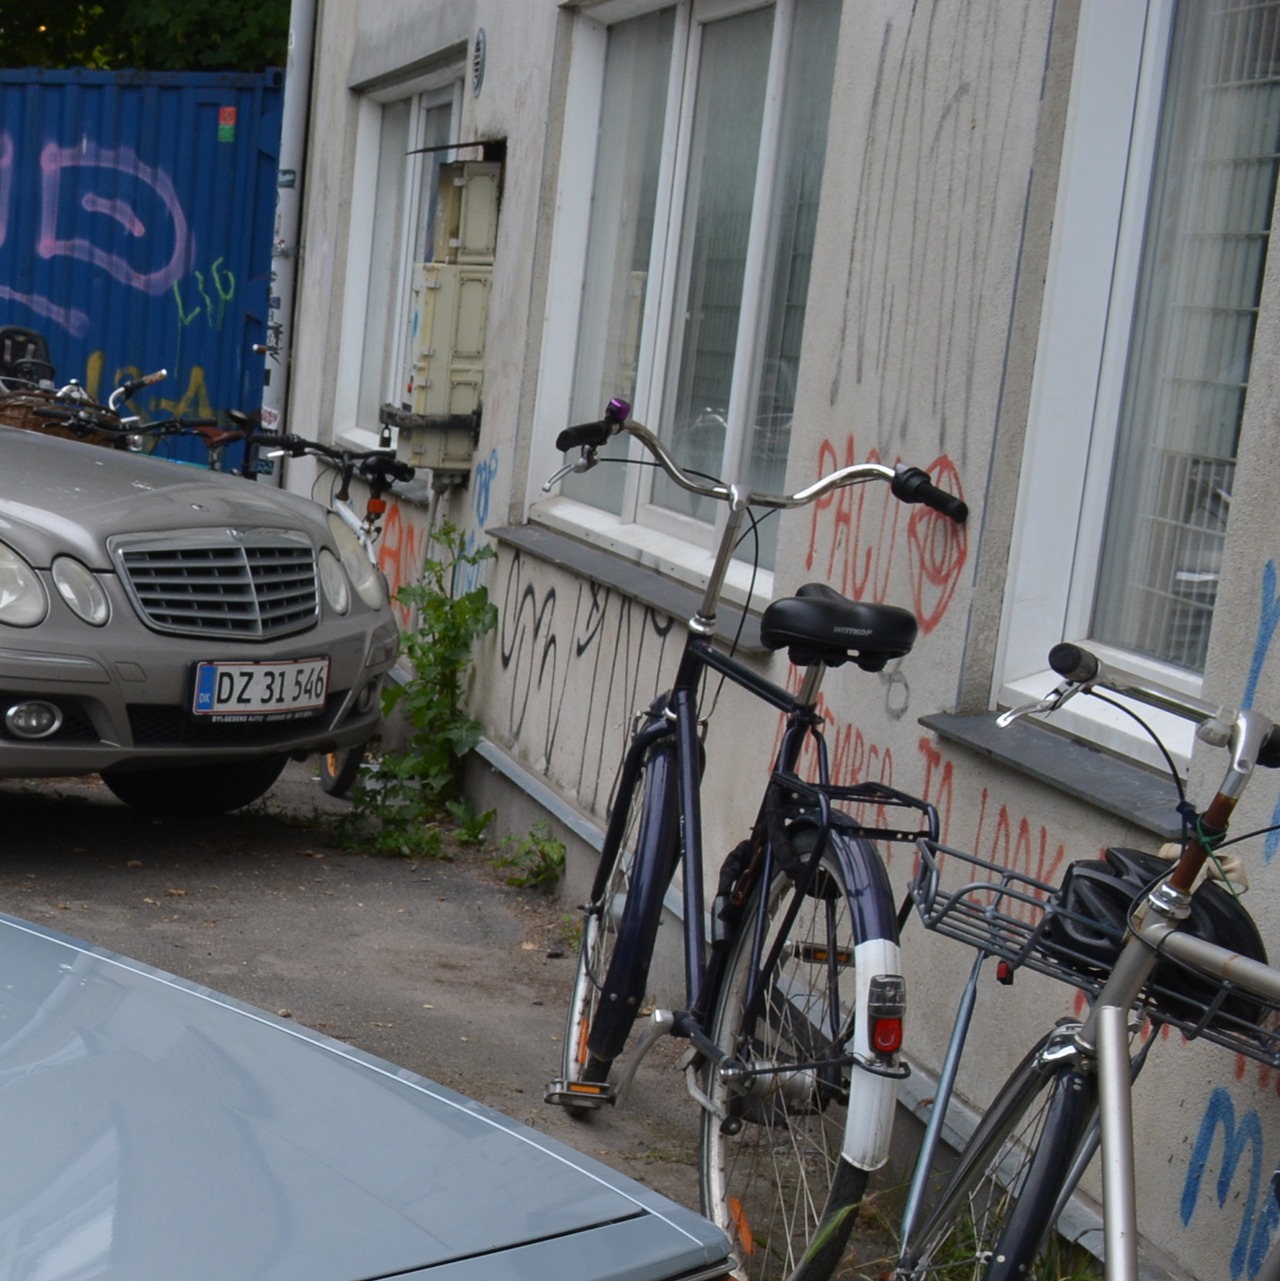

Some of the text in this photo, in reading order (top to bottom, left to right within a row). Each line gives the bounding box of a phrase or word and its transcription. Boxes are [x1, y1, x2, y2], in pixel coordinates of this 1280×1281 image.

[216, 666, 325, 704] DZ 31 546
[199, 692, 211, 703] DK
